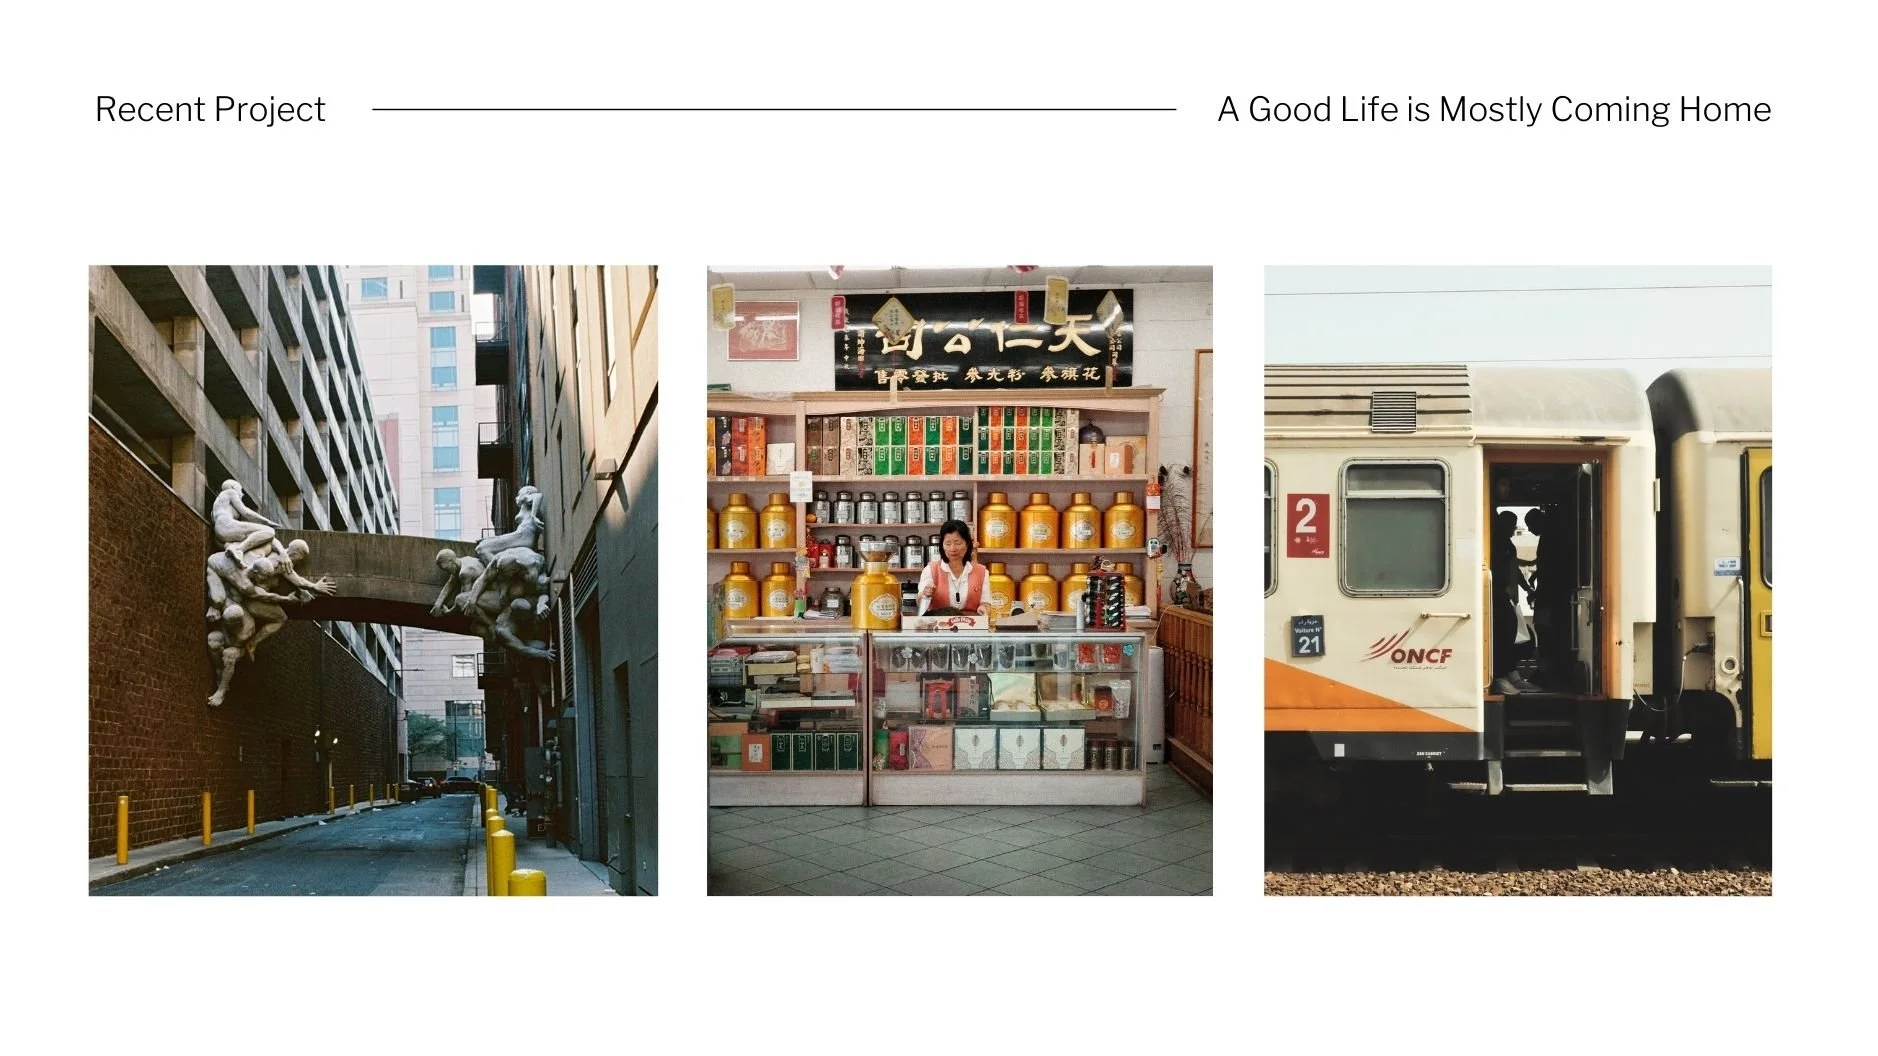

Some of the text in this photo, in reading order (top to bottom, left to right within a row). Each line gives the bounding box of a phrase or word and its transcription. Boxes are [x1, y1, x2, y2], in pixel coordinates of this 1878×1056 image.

[1295, 497, 1317, 534] 2
[1298, 635, 1320, 654] 21
[1391, 648, 1453, 664] ONCF
